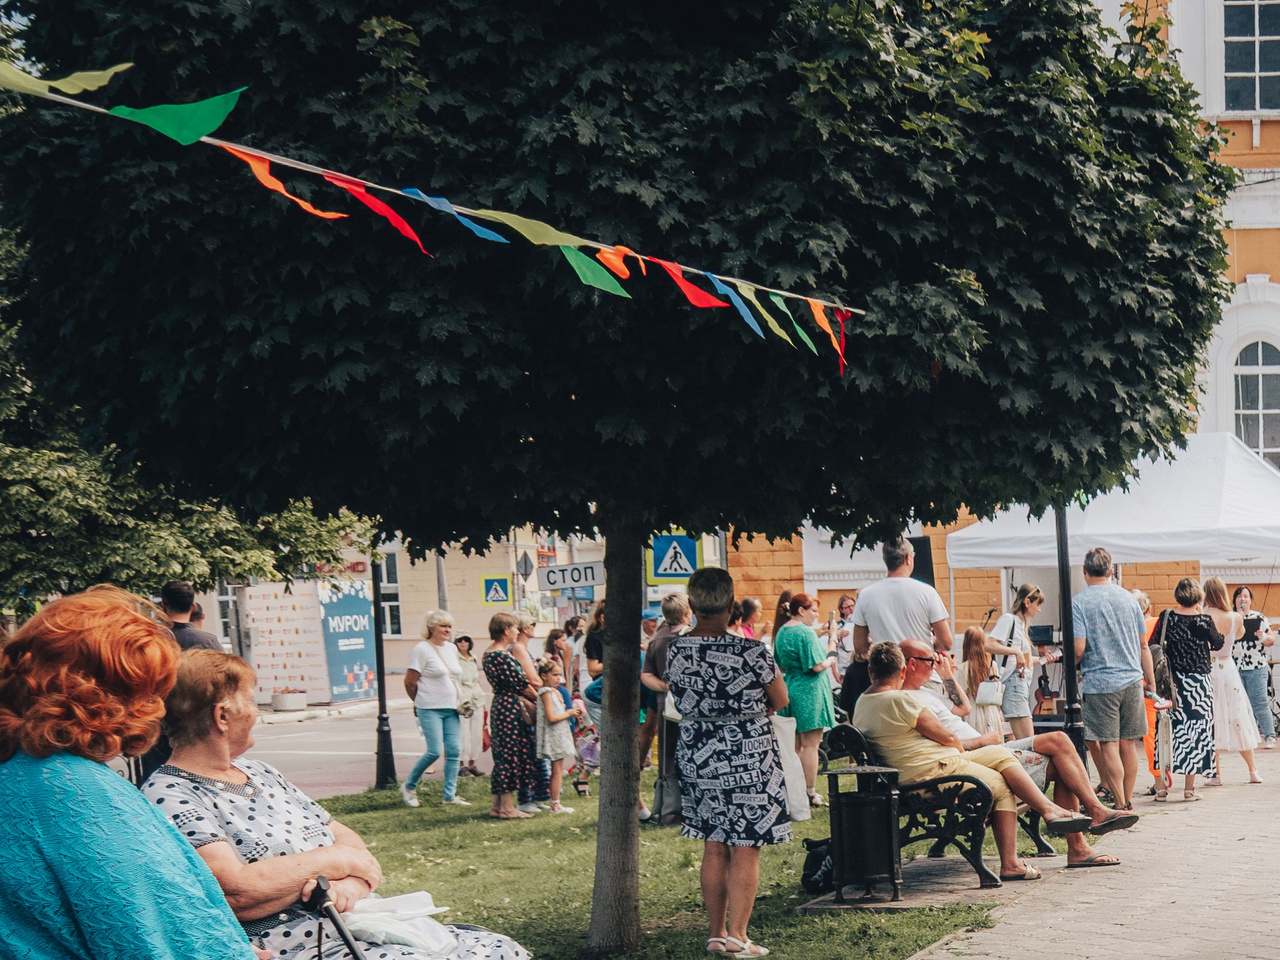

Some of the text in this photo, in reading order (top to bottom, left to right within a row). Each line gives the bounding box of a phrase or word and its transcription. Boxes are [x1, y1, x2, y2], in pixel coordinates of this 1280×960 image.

[546, 565, 596, 586] СТОП
[327, 614, 370, 633] МУРОМ
[722, 770, 761, 789] FEVER
